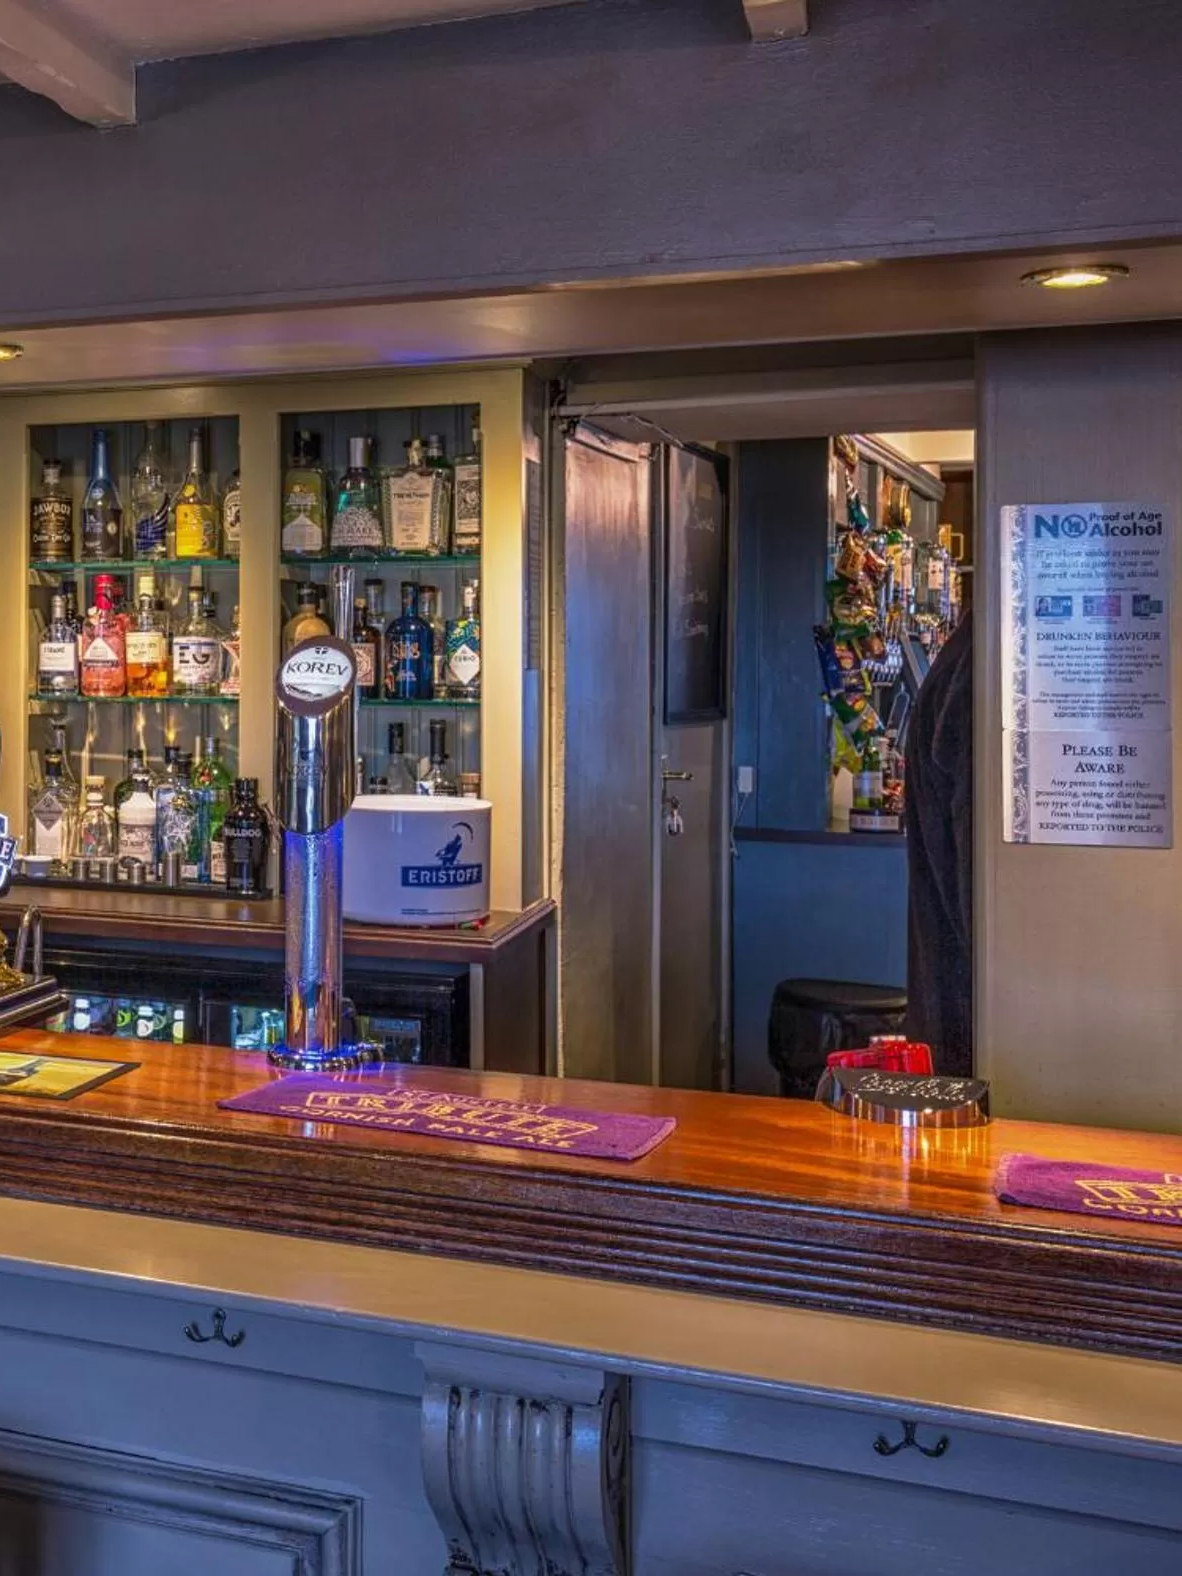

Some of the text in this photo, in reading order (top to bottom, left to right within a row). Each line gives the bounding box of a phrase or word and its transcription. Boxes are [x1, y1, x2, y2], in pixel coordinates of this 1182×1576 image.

[1089, 511, 1163, 523] Proof of Age
[1088, 521, 1163, 538] Alcohol
[1036, 632, 1162, 641] DRUNKEN BEHAVIOUR
[286, 661, 349, 675] KOREV
[1062, 744, 1139, 757] PLEASE BE
[1074, 762, 1126, 774] AWARE
[408, 868, 480, 884] ERISTOFF
[279, 1105, 578, 1149] CORNISH PALE ALE
